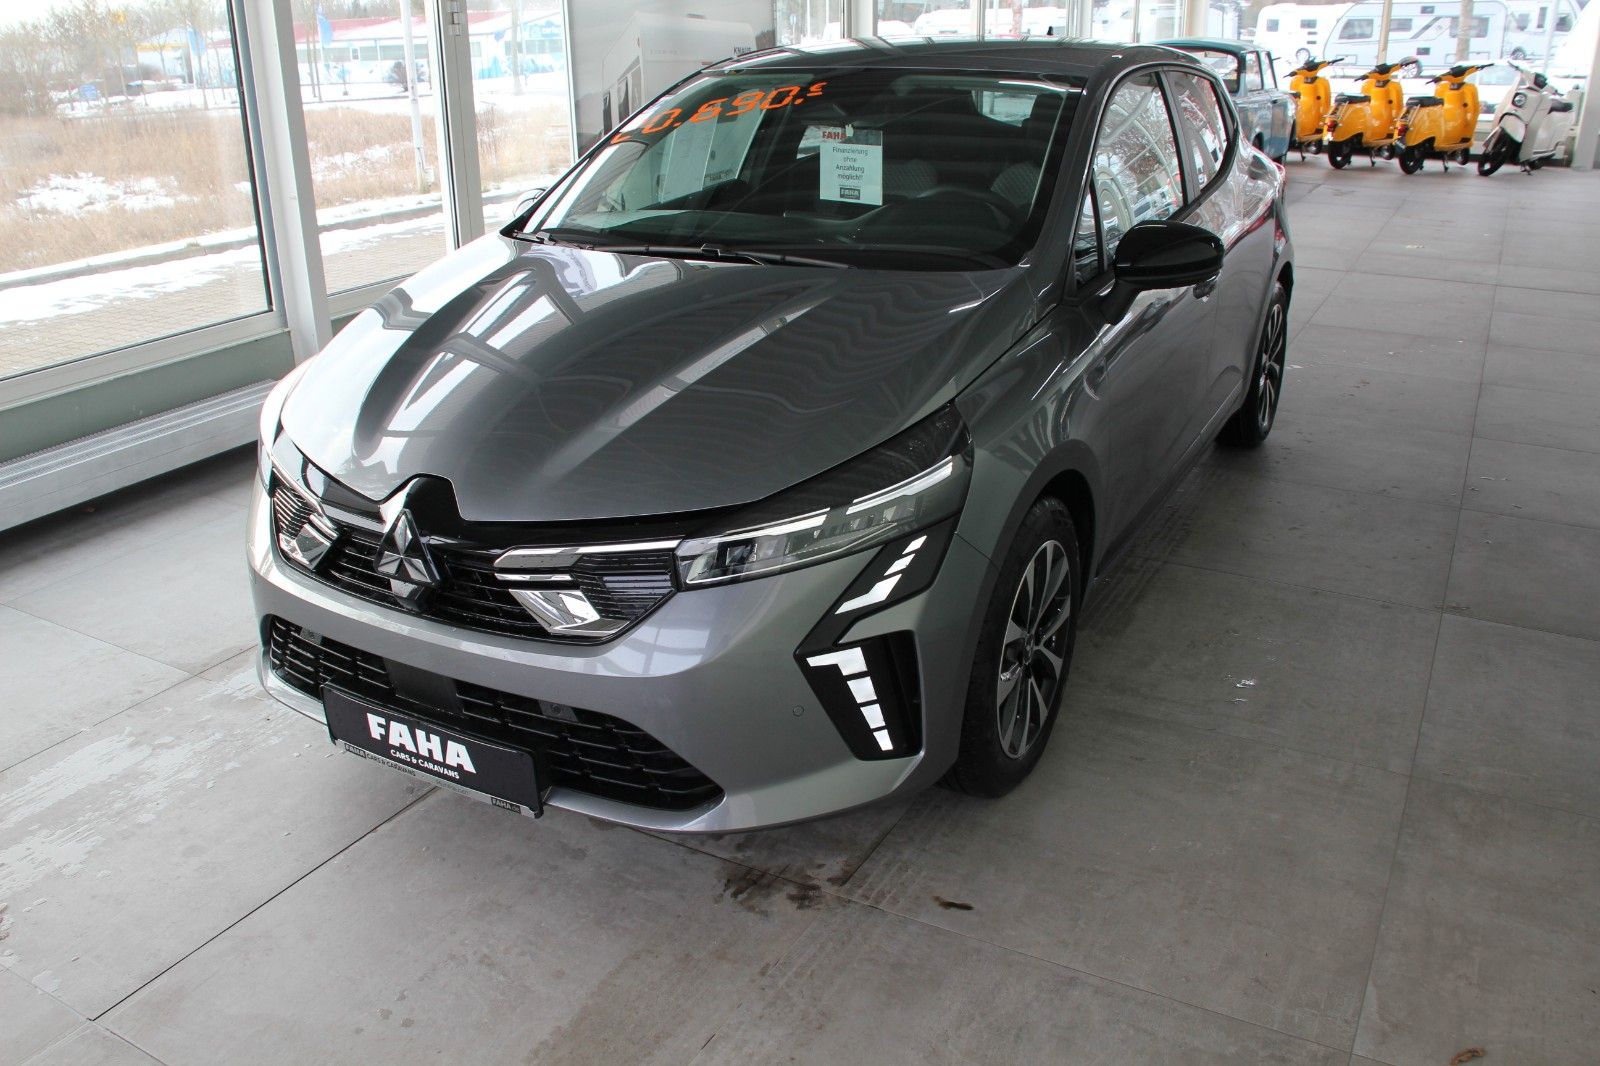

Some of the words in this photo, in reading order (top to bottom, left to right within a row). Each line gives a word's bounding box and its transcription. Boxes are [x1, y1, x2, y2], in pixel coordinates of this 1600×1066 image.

[832, 146, 868, 156] Finanzierung
[835, 163, 865, 174] Anzahlung
[366, 712, 477, 774] FAHA
[390, 749, 411, 762] CARS
[418, 759, 460, 779] CARAVANS
